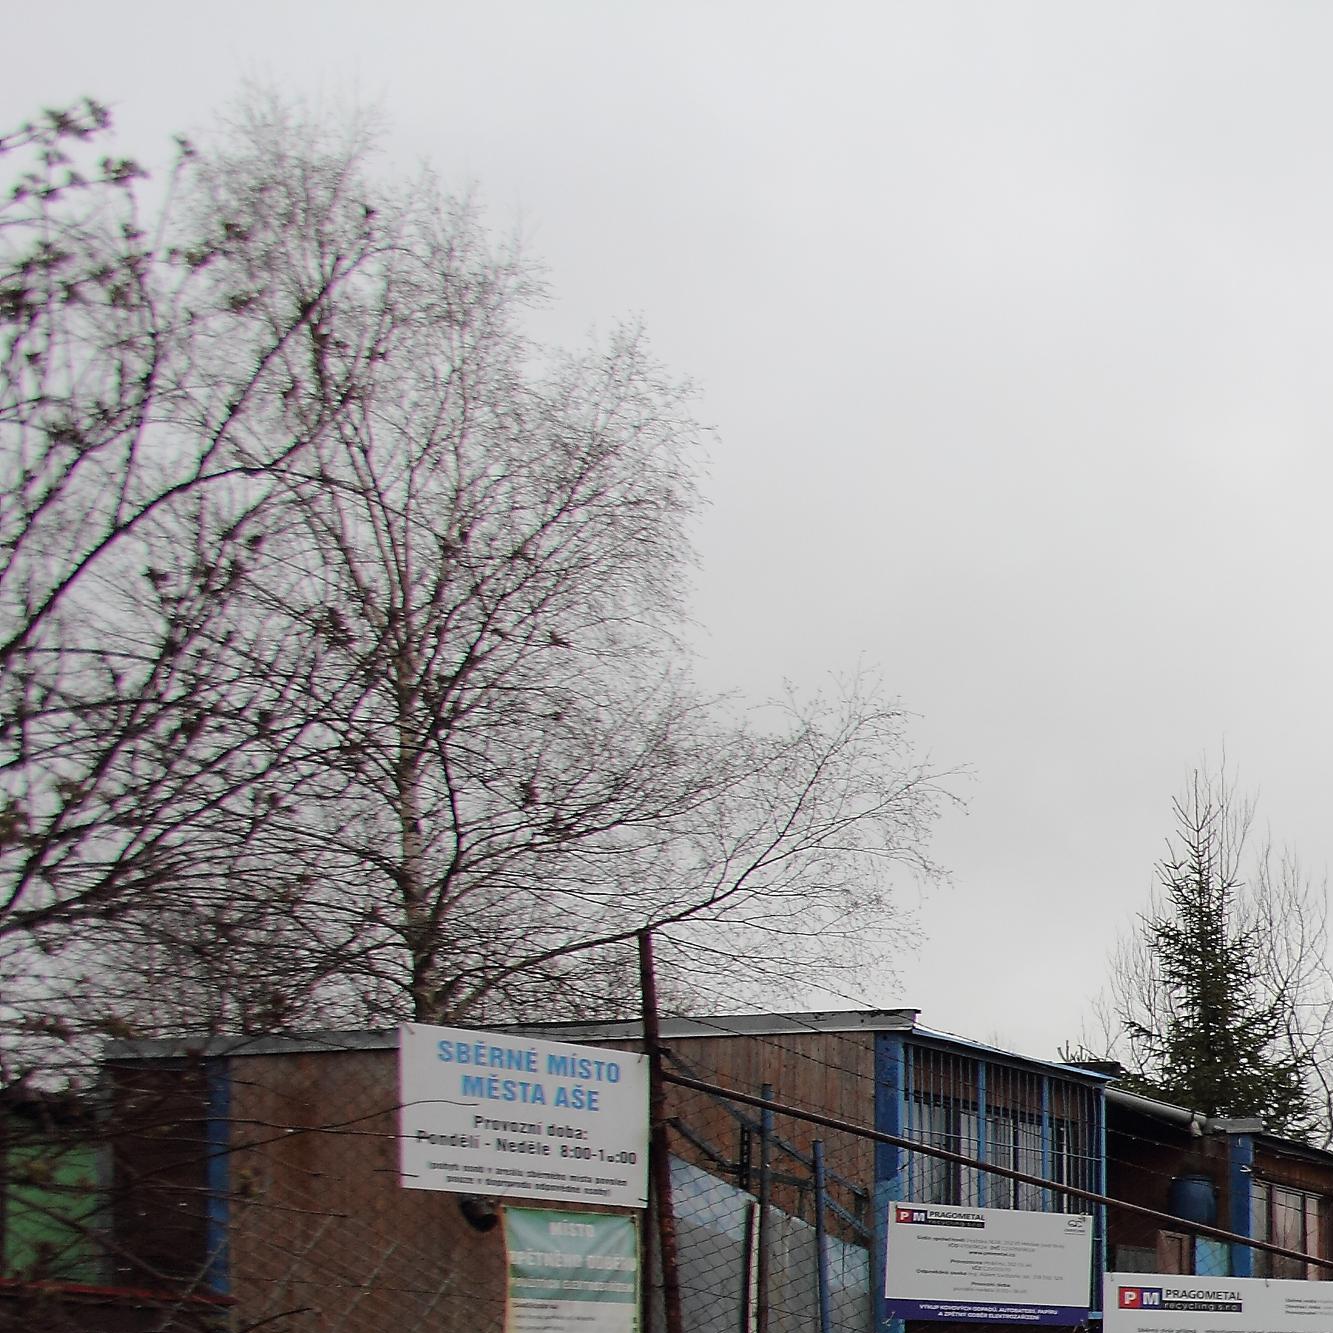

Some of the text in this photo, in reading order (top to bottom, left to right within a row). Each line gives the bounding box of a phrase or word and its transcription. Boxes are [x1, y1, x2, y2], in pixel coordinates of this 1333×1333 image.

[437, 1040, 621, 1084] SBĚRNÉ MÍSTO
[461, 1074, 600, 1111] MĚSTA AŠE
[473, 1115, 589, 1141] Provozní doba:
[416, 1129, 480, 1149] Pondělí
[496, 1137, 550, 1156] Neděle
[929, 1211, 985, 1220] PRAGOMETAL
[1164, 1302, 1215, 1311] recycling
[1165, 1289, 1243, 1301] PRAGOMETAL
